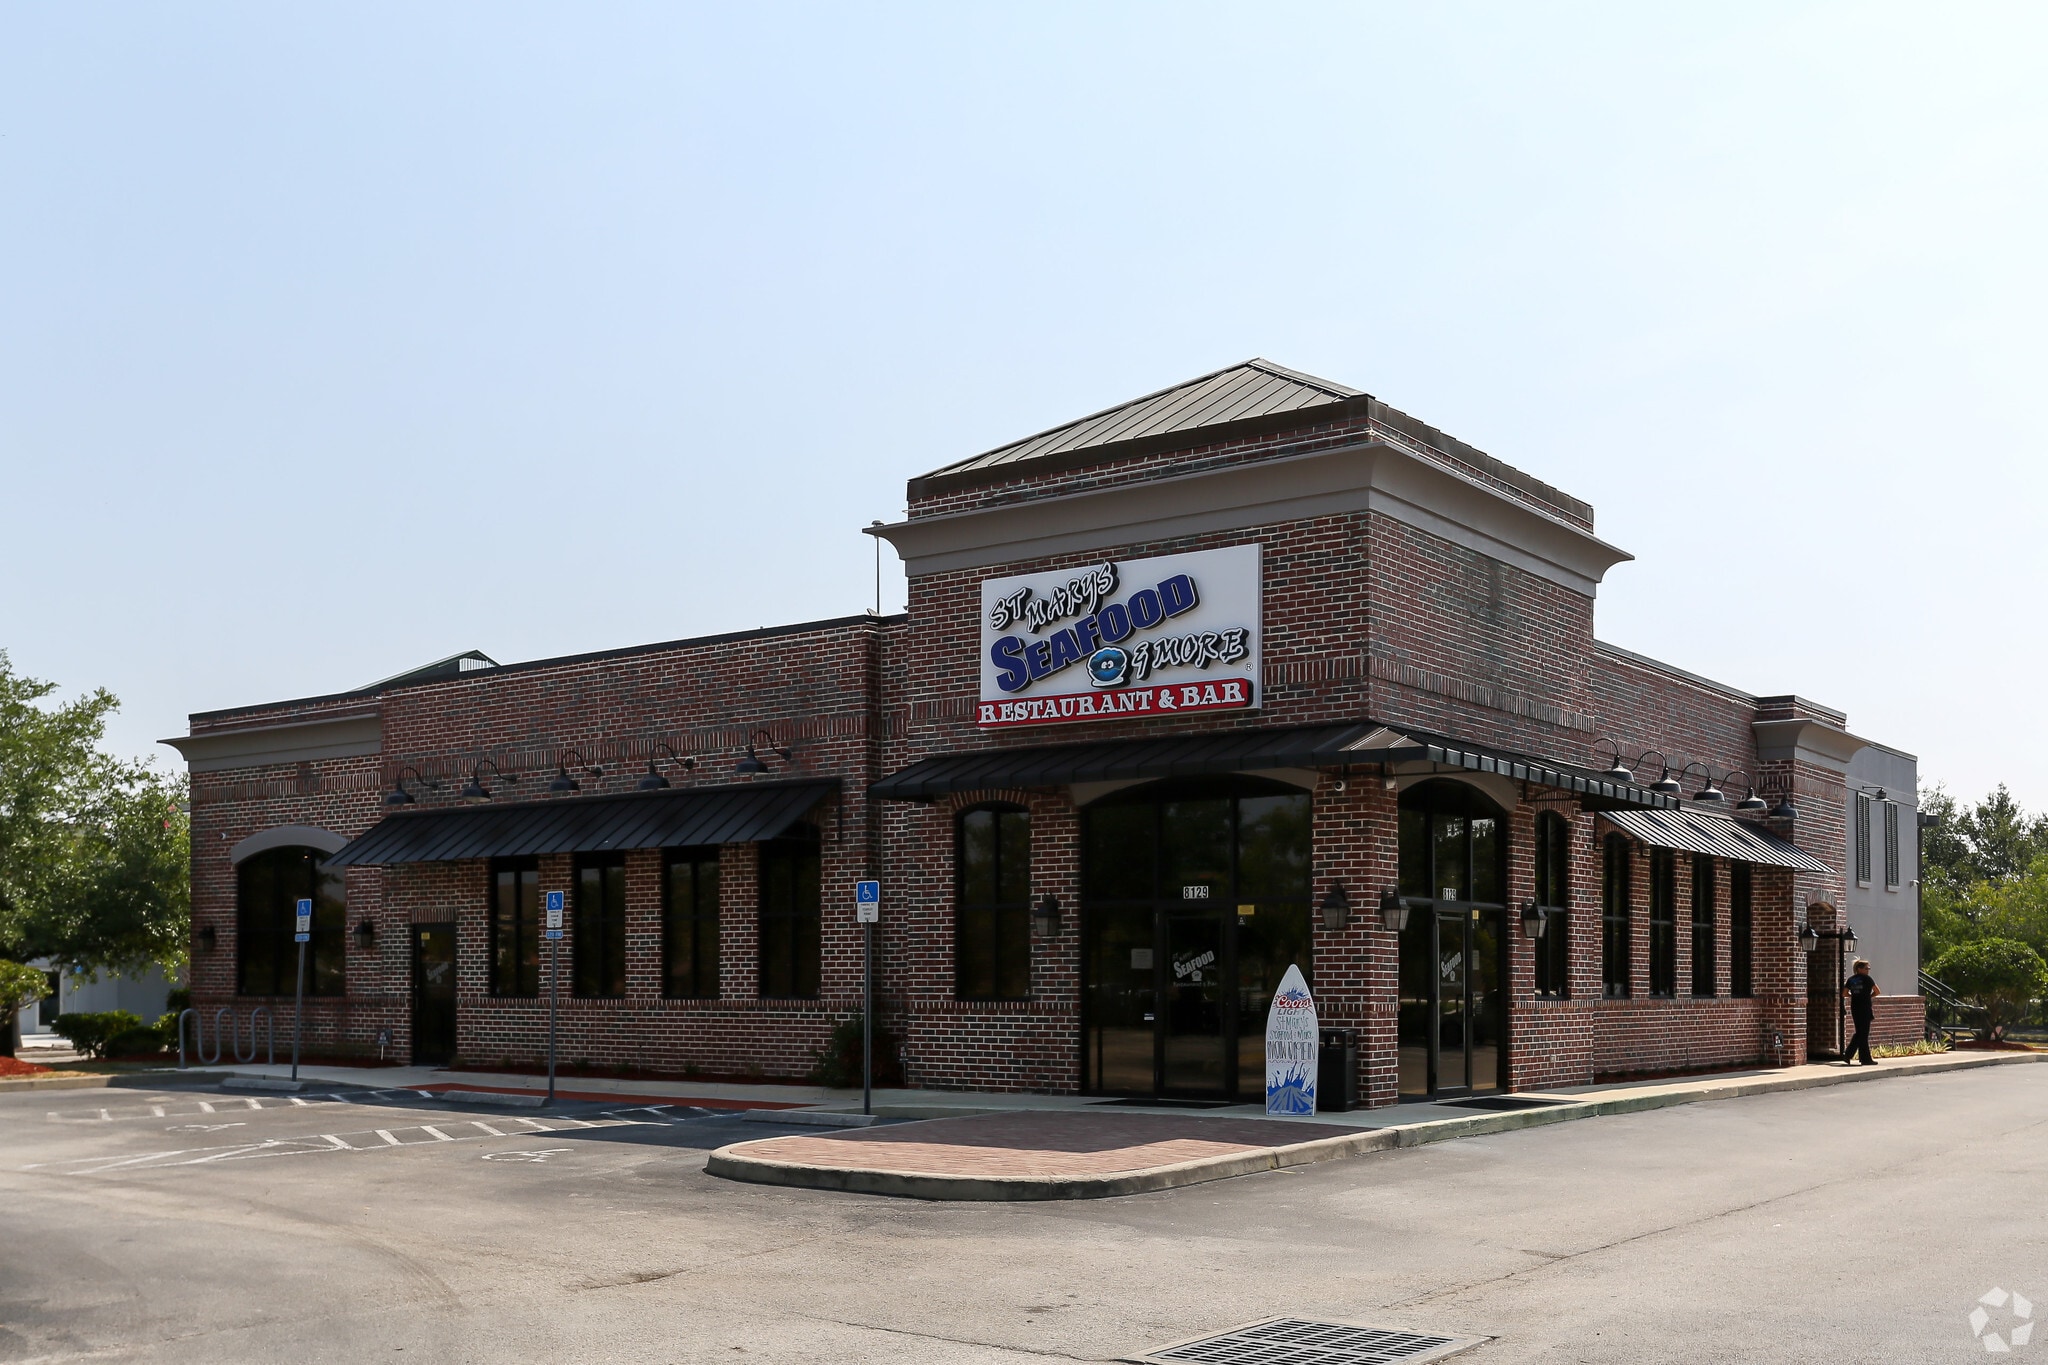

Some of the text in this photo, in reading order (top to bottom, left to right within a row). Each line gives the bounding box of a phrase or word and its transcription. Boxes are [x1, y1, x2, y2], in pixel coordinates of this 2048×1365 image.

[989, 560, 1119, 634] ST MARYS
[990, 573, 1200, 693] SEAFOOD
[978, 681, 1246, 724] RESTAURANT & BAR
[1184, 886, 1208, 899] 8129
[1173, 950, 1216, 979] SEAFOOD
[1276, 994, 1310, 1008] Coors
[1277, 1008, 1306, 1016] LIGHT
